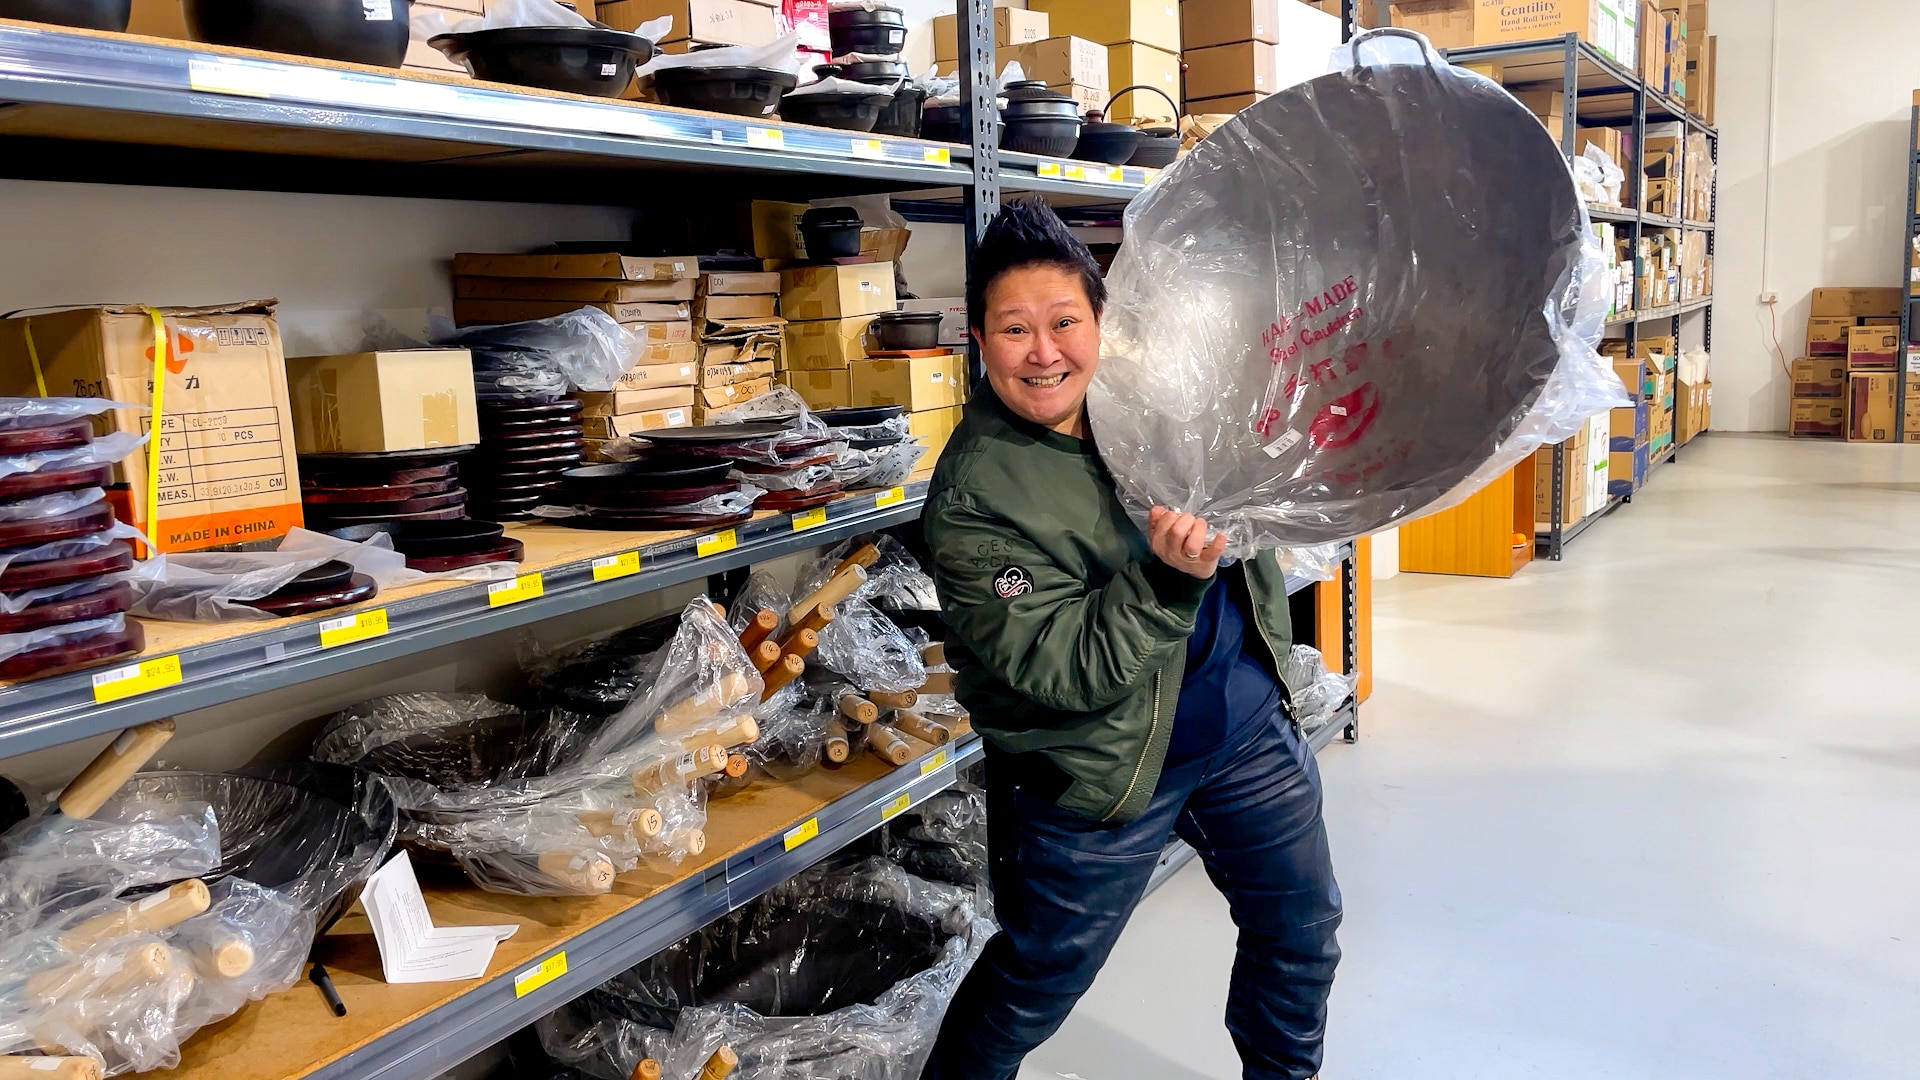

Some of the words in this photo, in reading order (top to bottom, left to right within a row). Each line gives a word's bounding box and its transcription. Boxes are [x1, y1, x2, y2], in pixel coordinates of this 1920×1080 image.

[1500, 1, 1557, 17] Gentility
[1500, 18, 1521, 27] Hand
[1523, 15, 1538, 24] Roll
[1540, 12, 1562, 21] Towel
[147, 419, 175, 430] TPE
[234, 430, 254, 441] PCS
[269, 478, 283, 488] CM
[169, 531, 211, 546] MADE
[215, 526, 230, 539] IN
[233, 519, 276, 536] CHINA
[360, 615, 385, 628] $18.95
[145, 662, 176, 678] $24.95
[863, 708, 873, 717] 13
[898, 751, 906, 760] 13
[646, 814, 658, 832] 15
[695, 832, 704, 852] 15
[597, 871, 610, 882] 15
